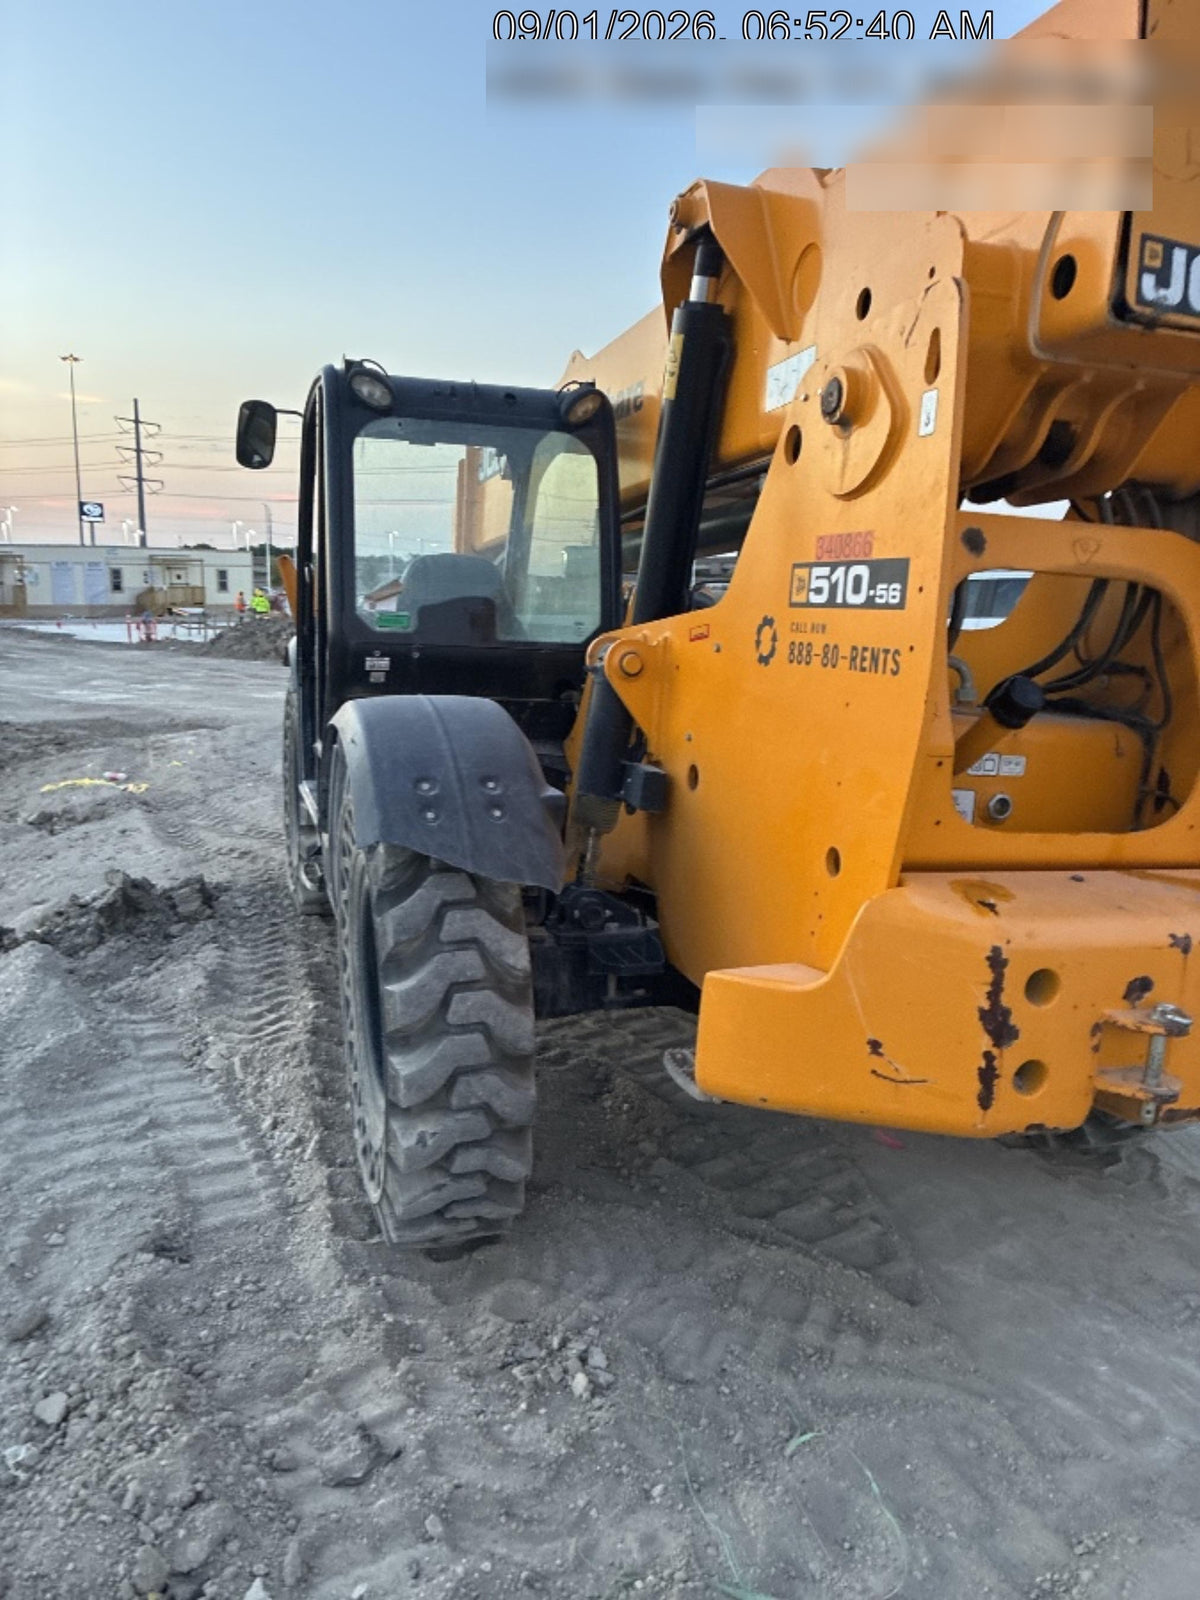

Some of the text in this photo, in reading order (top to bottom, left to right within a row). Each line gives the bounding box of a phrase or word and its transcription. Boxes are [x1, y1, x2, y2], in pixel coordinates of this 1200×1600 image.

[790, 621, 827, 635] CALL NOW
[788, 641, 902, 676] 888-80-RENTS
